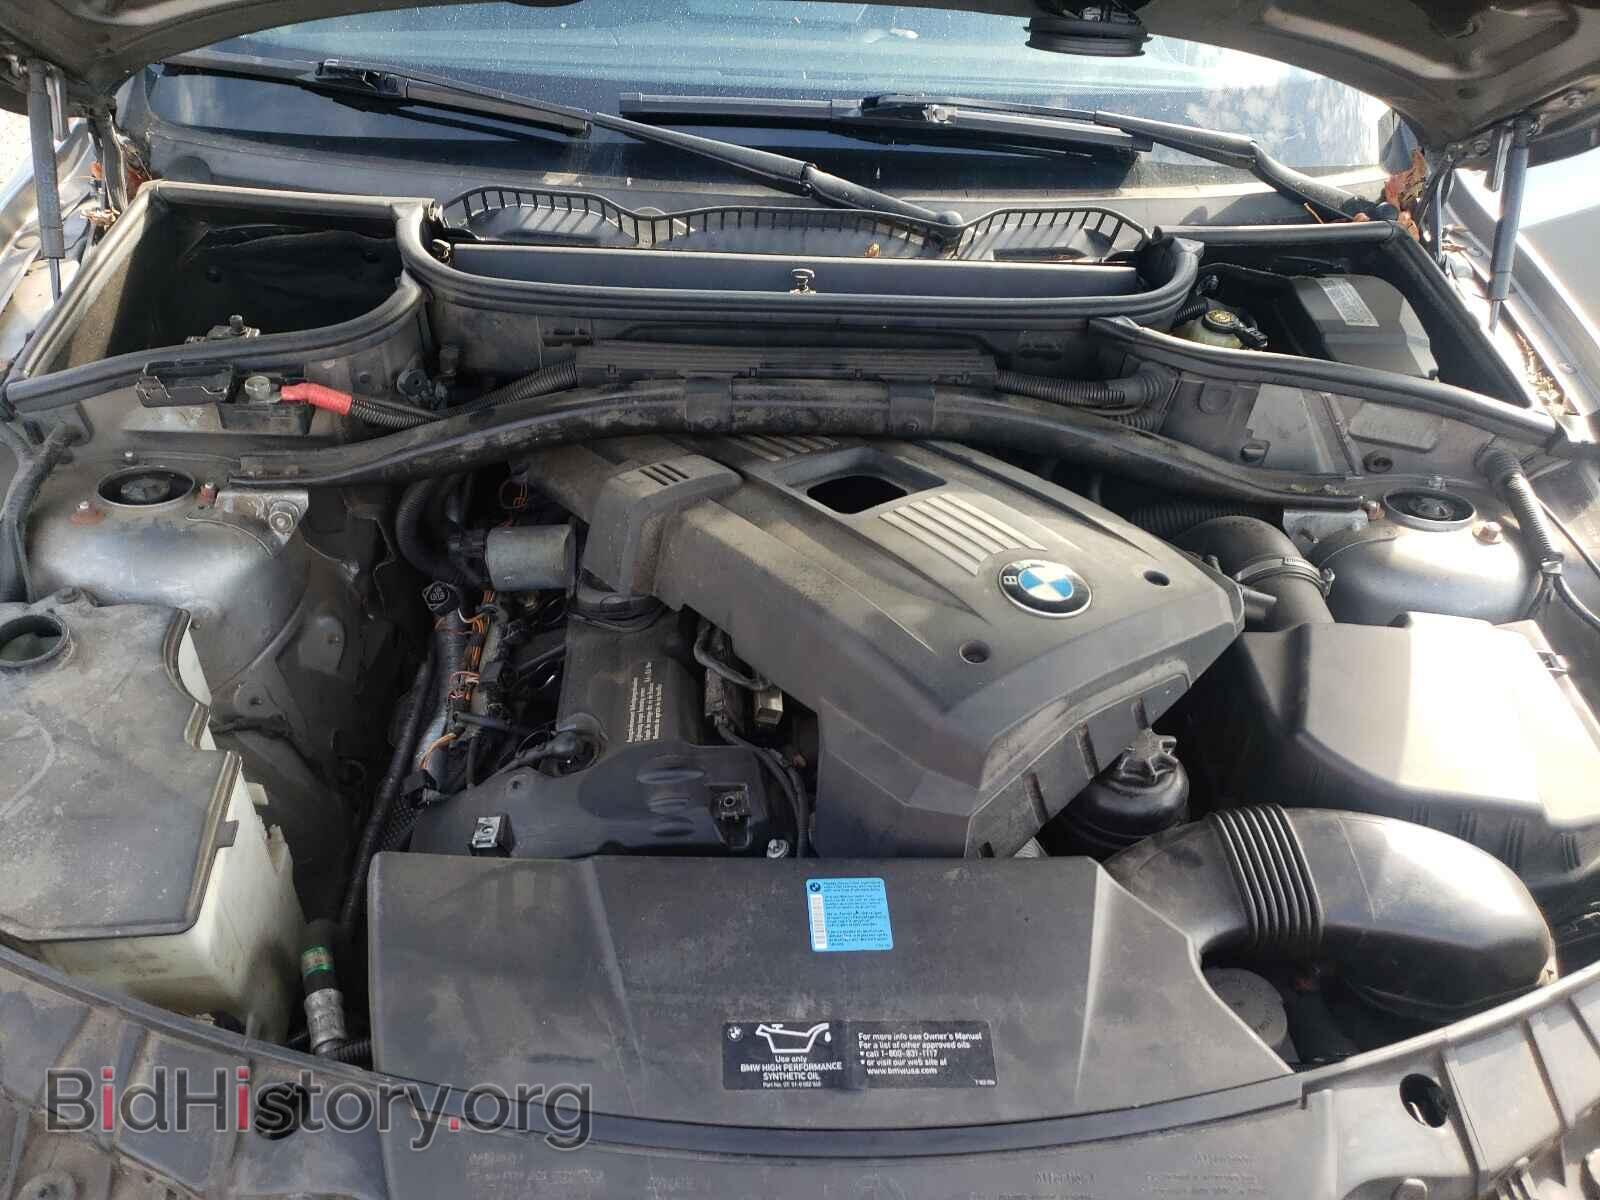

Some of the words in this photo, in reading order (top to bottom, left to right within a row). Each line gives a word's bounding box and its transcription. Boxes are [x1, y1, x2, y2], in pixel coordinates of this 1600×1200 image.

[858, 1032, 871, 1040] For
[872, 1033, 892, 1041] more
[893, 1032, 907, 1040] info
[923, 1031, 954, 1040] Owner's
[955, 1031, 982, 1040] Manual
[858, 1041, 872, 1049] For
[879, 1041, 891, 1049] list
[892, 1041, 900, 1049] of
[900, 1041, 920, 1049] other
[921, 1041, 956, 1050] approved
[956, 1041, 971, 1049] oils
[865, 1050, 879, 1058] call
[774, 1055, 790, 1063] Use
[790, 1055, 808, 1064] only
[876, 1058, 891, 1066] visit
[907, 1058, 923, 1066] web
[924, 1058, 939, 1066] site
[939, 1058, 947, 1066] at
[740, 1063, 761, 1072] BMW
[761, 1063, 781, 1072] HIGH
[782, 1061, 843, 1072] PERFORMANCE
[866, 1067, 938, 1075] www.bmwusa.com
[762, 1071, 806, 1081] SYNTHETIC
[807, 1071, 821, 1081] OIL
